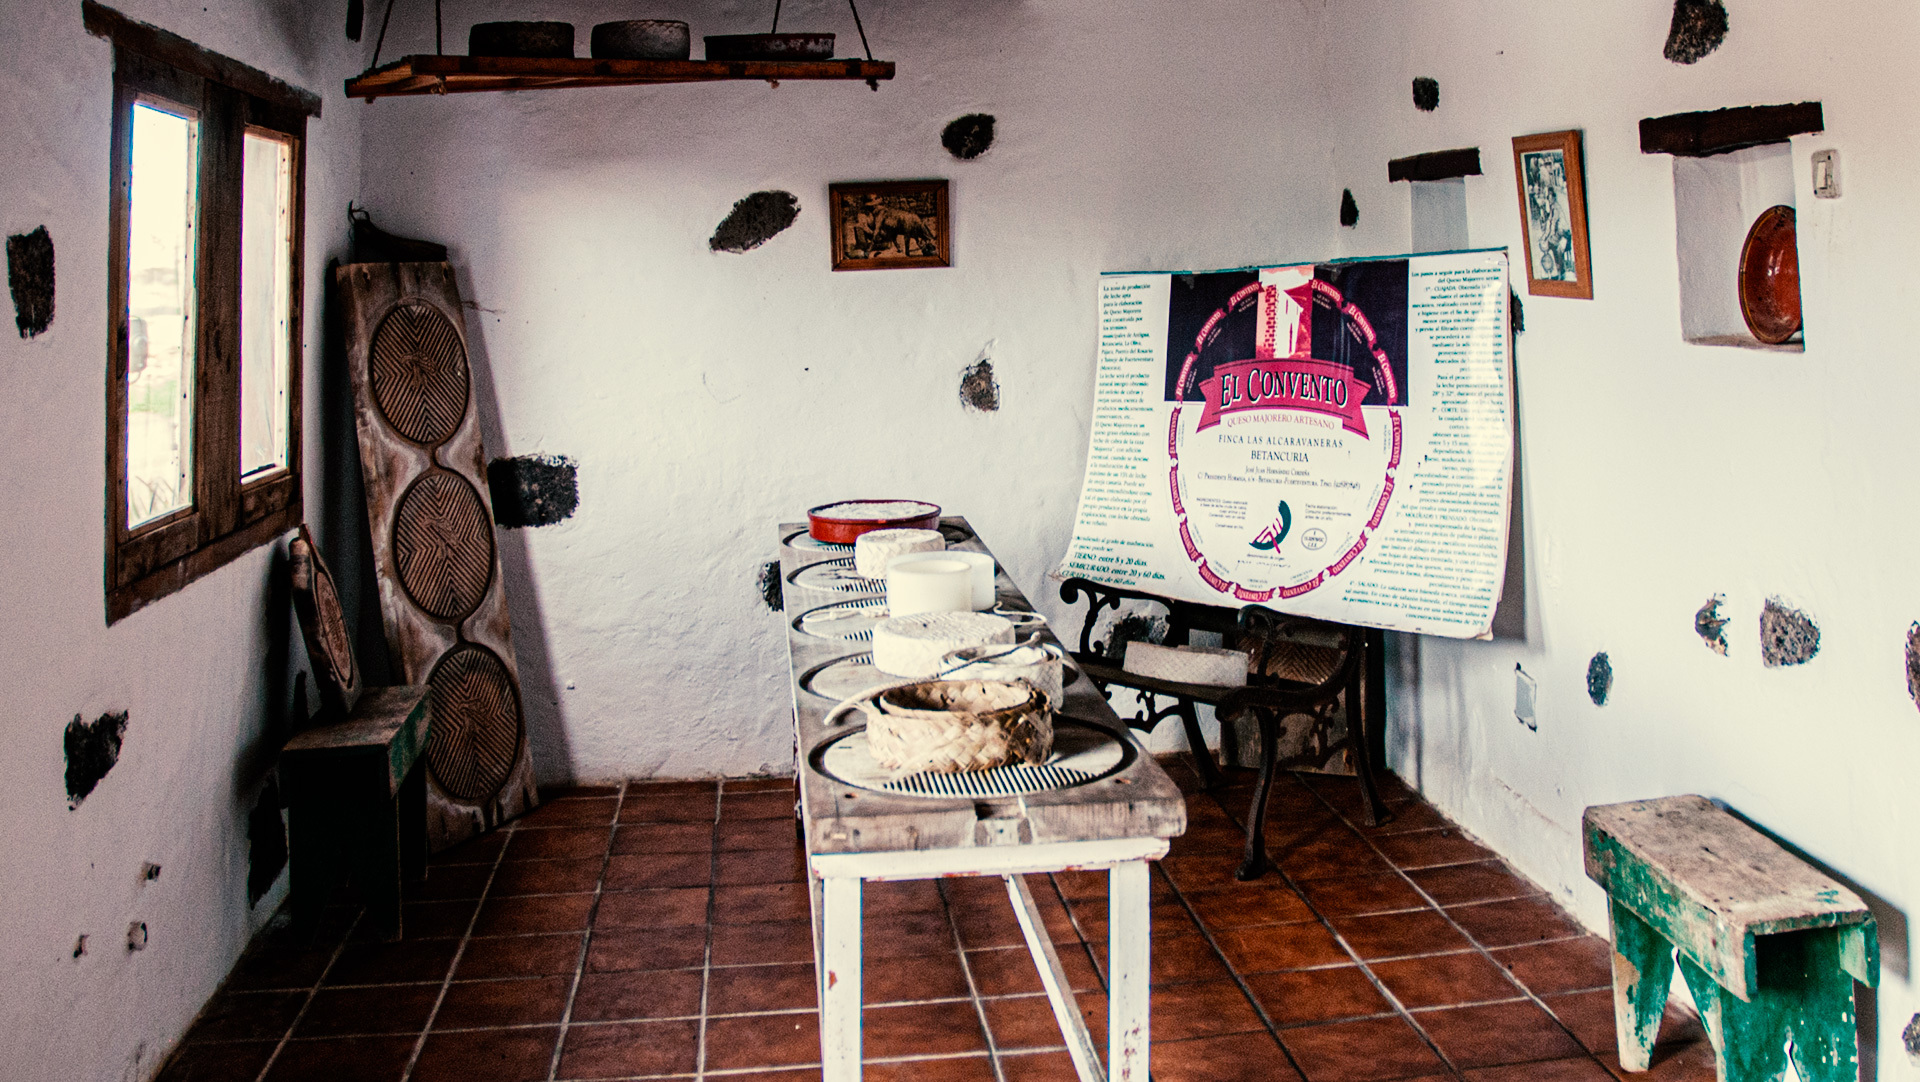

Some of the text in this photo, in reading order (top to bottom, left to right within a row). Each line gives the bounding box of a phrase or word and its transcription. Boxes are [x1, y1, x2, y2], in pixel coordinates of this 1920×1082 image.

[1220, 373, 1242, 410] EL
[1247, 368, 1348, 408] CONVENTO
[1227, 414, 1335, 430] QUESO MAJORERO ARTESANO
[1218, 434, 1343, 448] FINCA LAS ALCARAVANERAS
[1251, 450, 1309, 463] BETANCURIA
[1126, 557, 1133, 565] 20
[1111, 567, 1128, 576] entre
